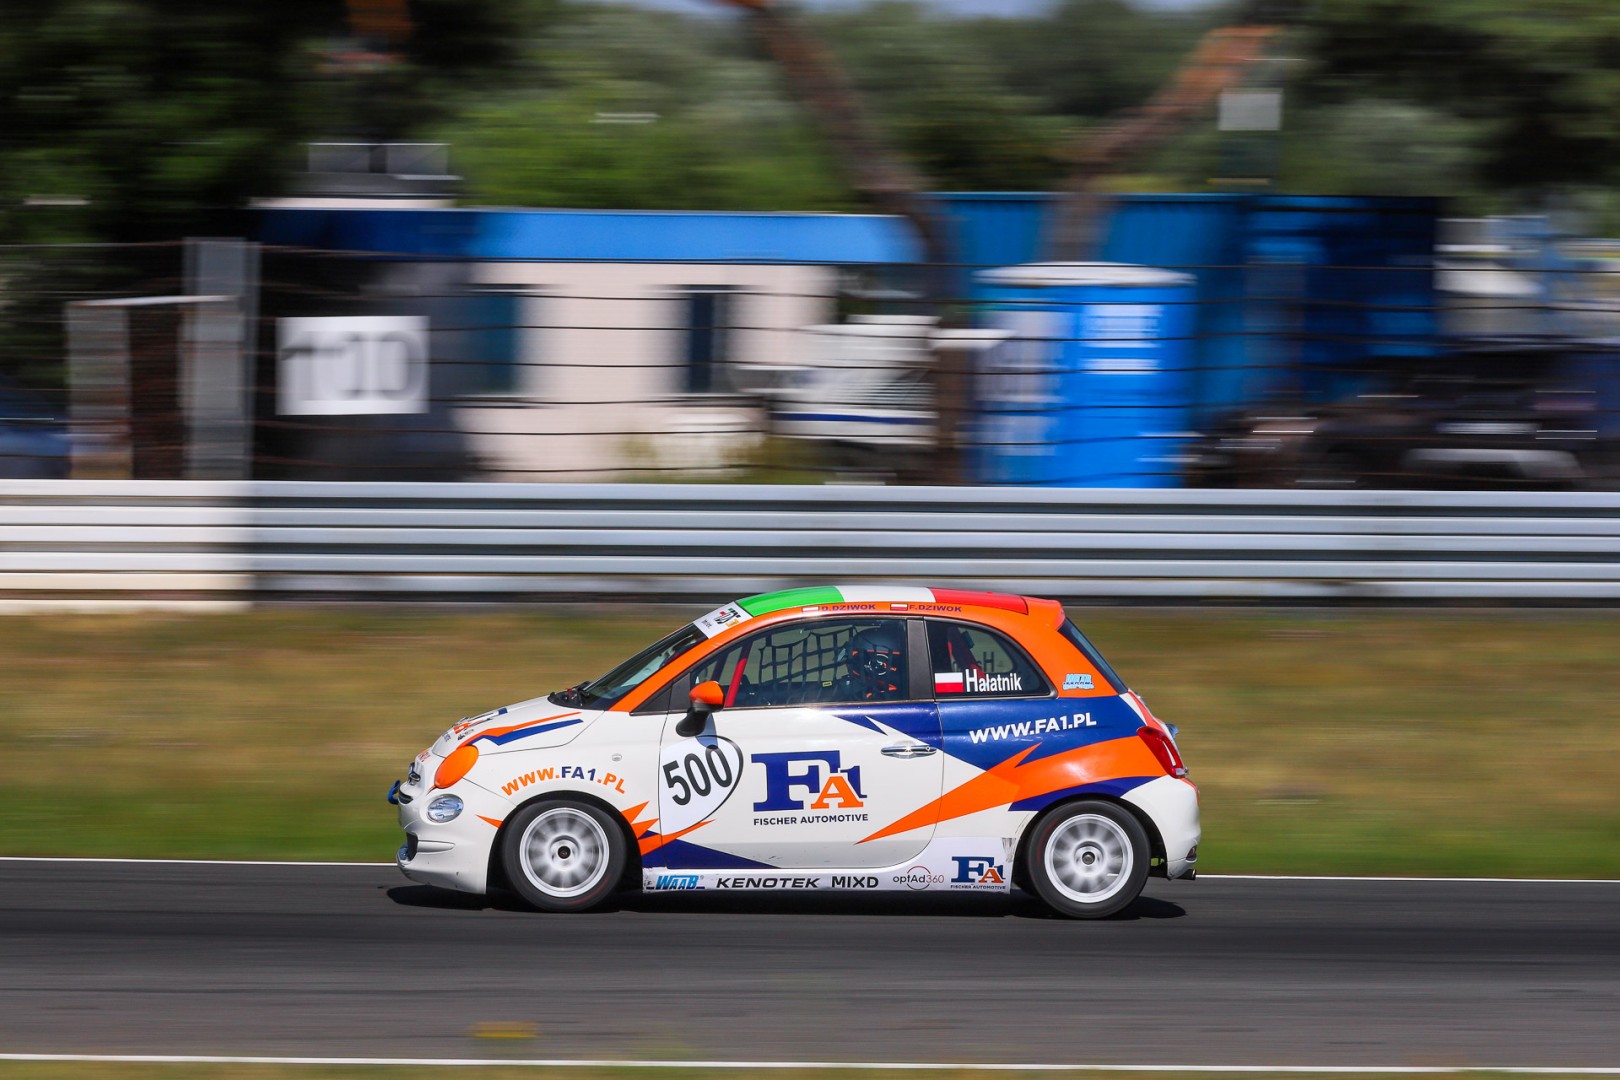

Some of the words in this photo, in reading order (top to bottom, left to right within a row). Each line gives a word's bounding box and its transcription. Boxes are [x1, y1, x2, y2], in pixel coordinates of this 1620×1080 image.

[821, 604, 876, 612] D.DZIWOK
[909, 604, 962, 613] F.DZIWOK
[969, 712, 1096, 744] WWW.FA1.PL
[501, 766, 626, 796] WWW.FA1.PL
[662, 744, 733, 806] 500
[751, 750, 868, 812] FA1
[753, 816, 797, 826] FISCHER
[800, 813, 869, 825] AUTOMOTIVE
[951, 856, 1006, 883] FA1
[716, 877, 821, 889] KENOTEK
[831, 875, 879, 889] MIXD
[892, 874, 945, 884] optAd360
